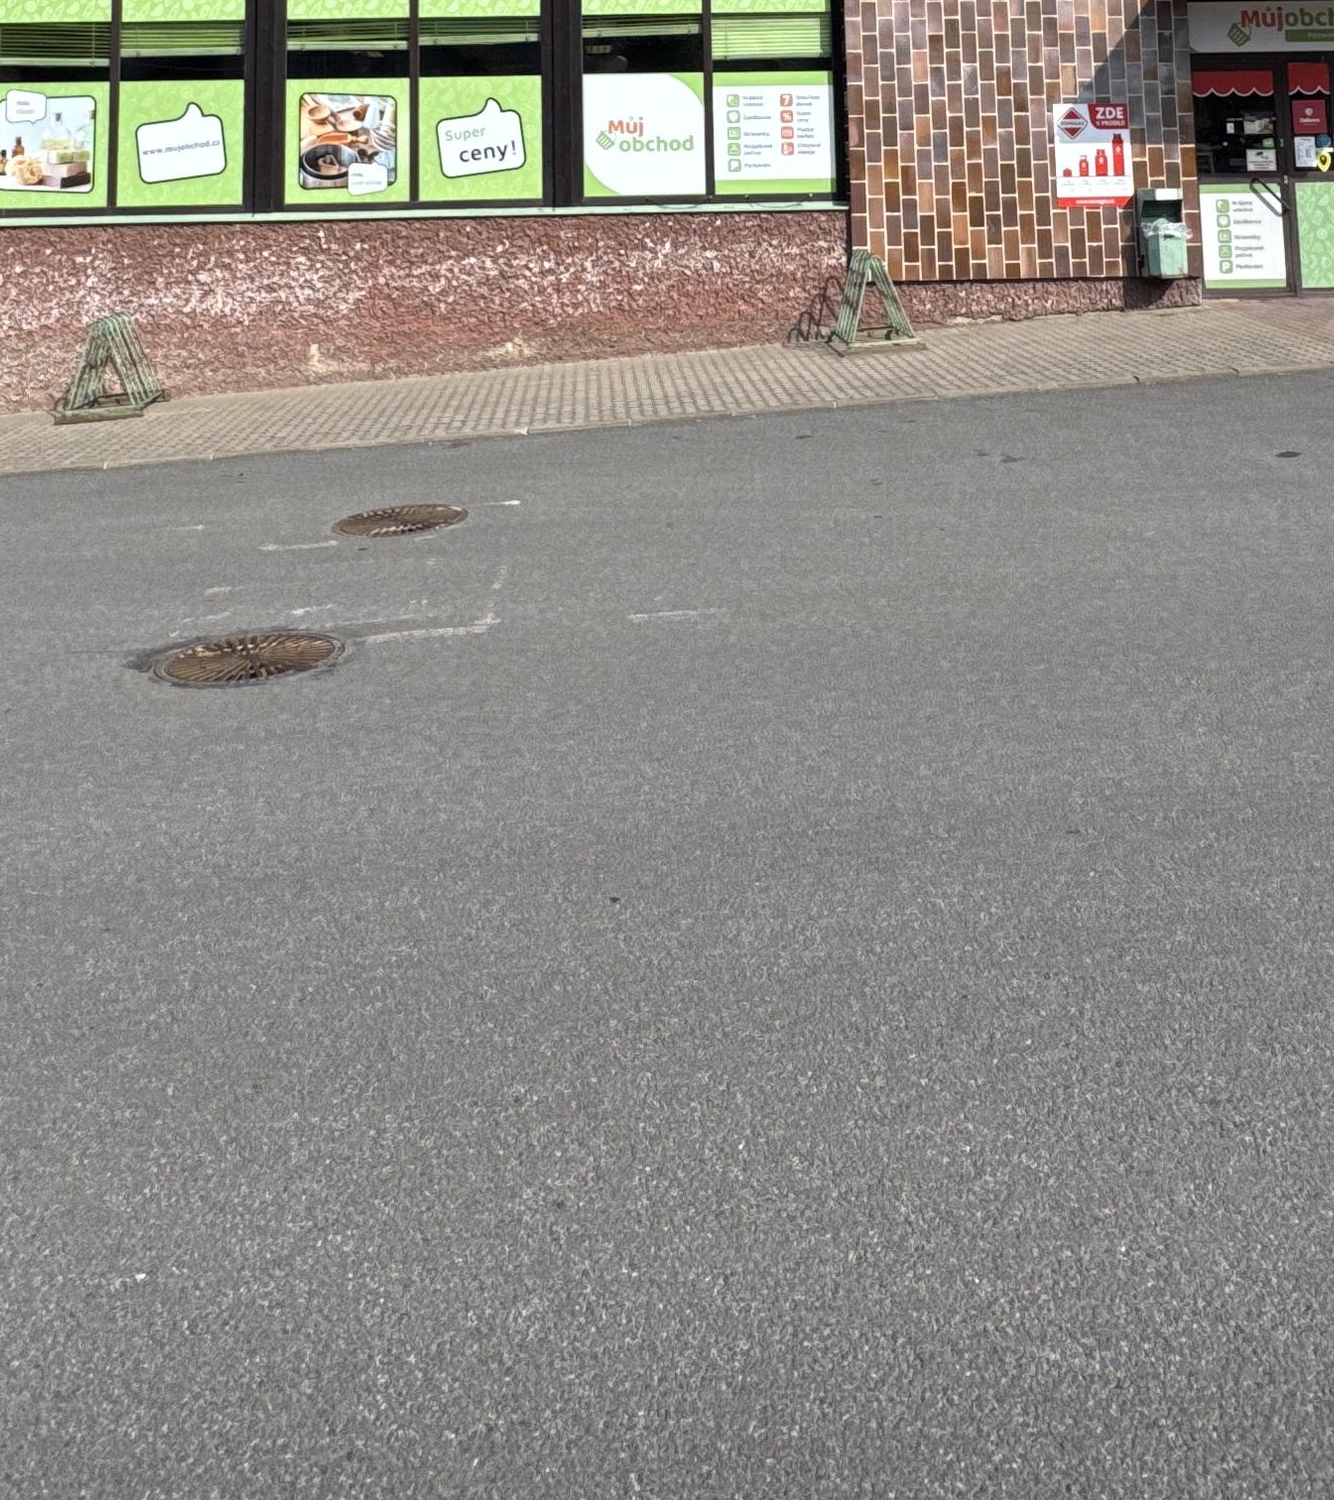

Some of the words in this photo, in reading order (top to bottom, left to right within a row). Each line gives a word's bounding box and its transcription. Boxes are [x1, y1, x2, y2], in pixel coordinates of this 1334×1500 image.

[1095, 106, 1124, 119] ZDE
[445, 127, 487, 141] Super
[608, 116, 644, 137] Můj
[619, 135, 694, 152] obchod
